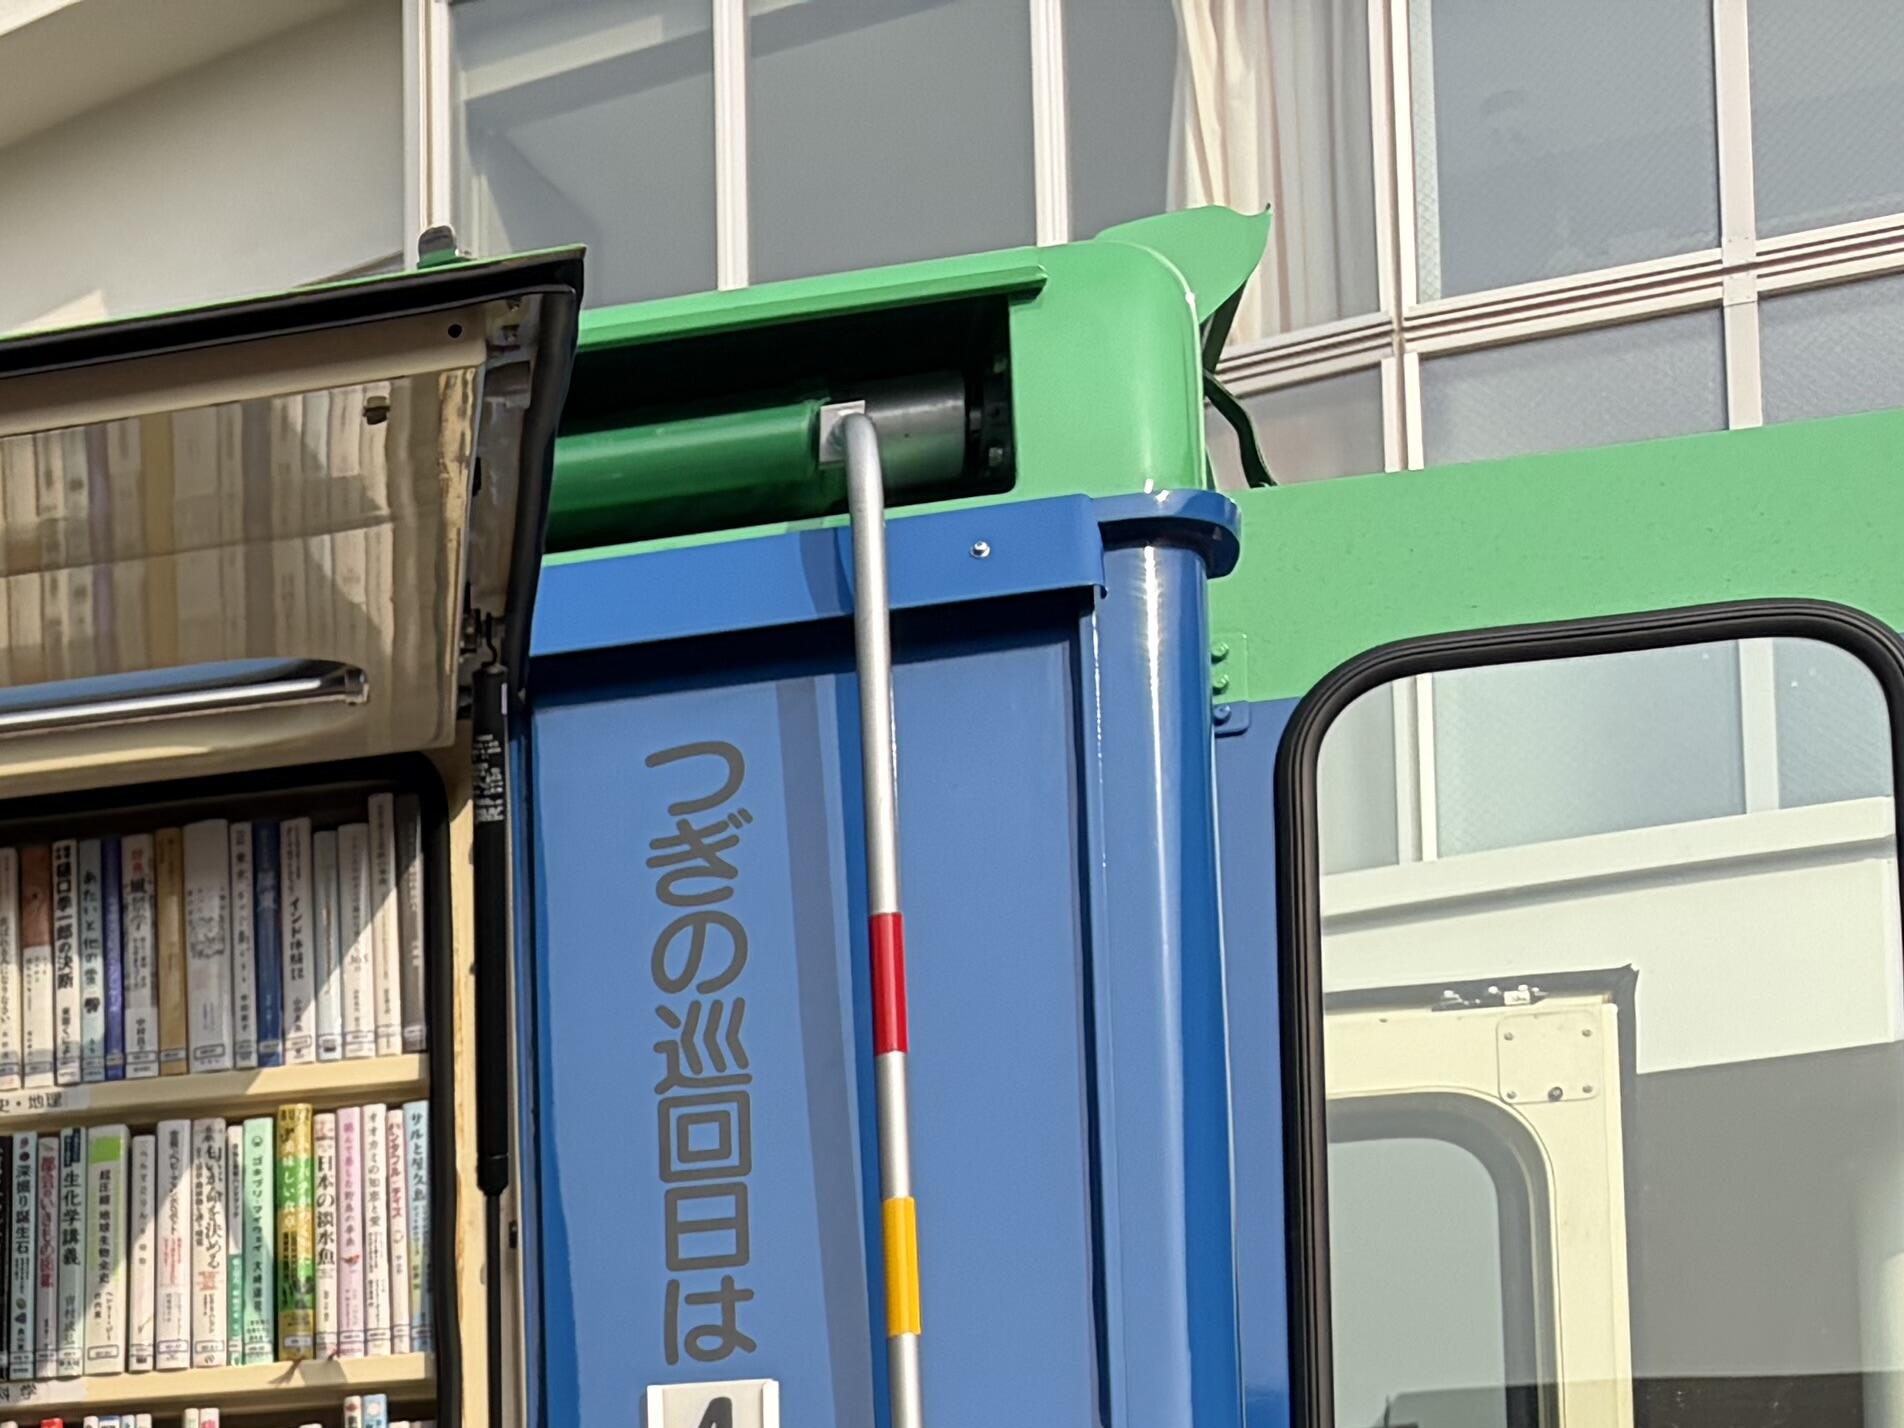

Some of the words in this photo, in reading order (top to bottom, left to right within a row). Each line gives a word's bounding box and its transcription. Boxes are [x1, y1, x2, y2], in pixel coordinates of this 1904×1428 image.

[644, 740, 757, 1366] つぎの巡回日は
[15, 1164, 32, 1255] 深掘り誕生石
[63, 1171, 81, 1266] 生化学講義
[316, 1156, 335, 1266] 日本の淡水魚
